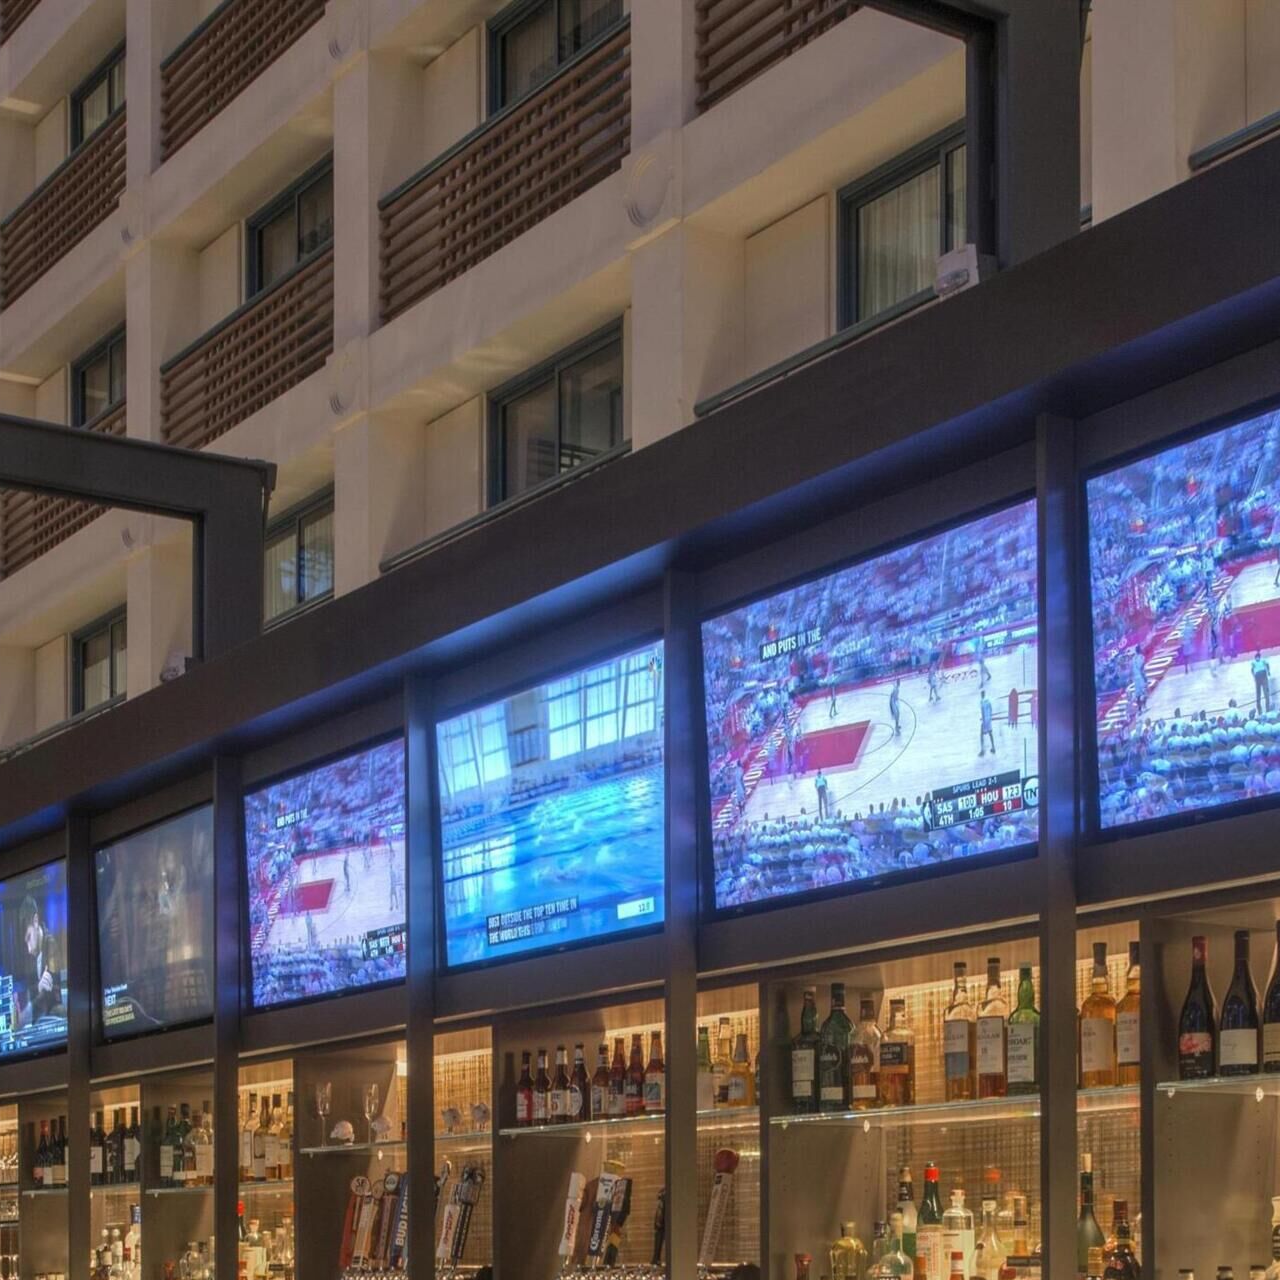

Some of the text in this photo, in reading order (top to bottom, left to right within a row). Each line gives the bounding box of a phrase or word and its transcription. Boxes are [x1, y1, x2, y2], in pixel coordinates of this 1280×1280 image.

[762, 642, 777, 660] AND
[778, 635, 797, 654] PUTS
[797, 632, 806, 647] IN
[937, 801, 954, 815] SAS
[981, 790, 999, 804] HOU
[939, 813, 954, 826] 4TH
[395, 1221, 408, 1247] BUD
